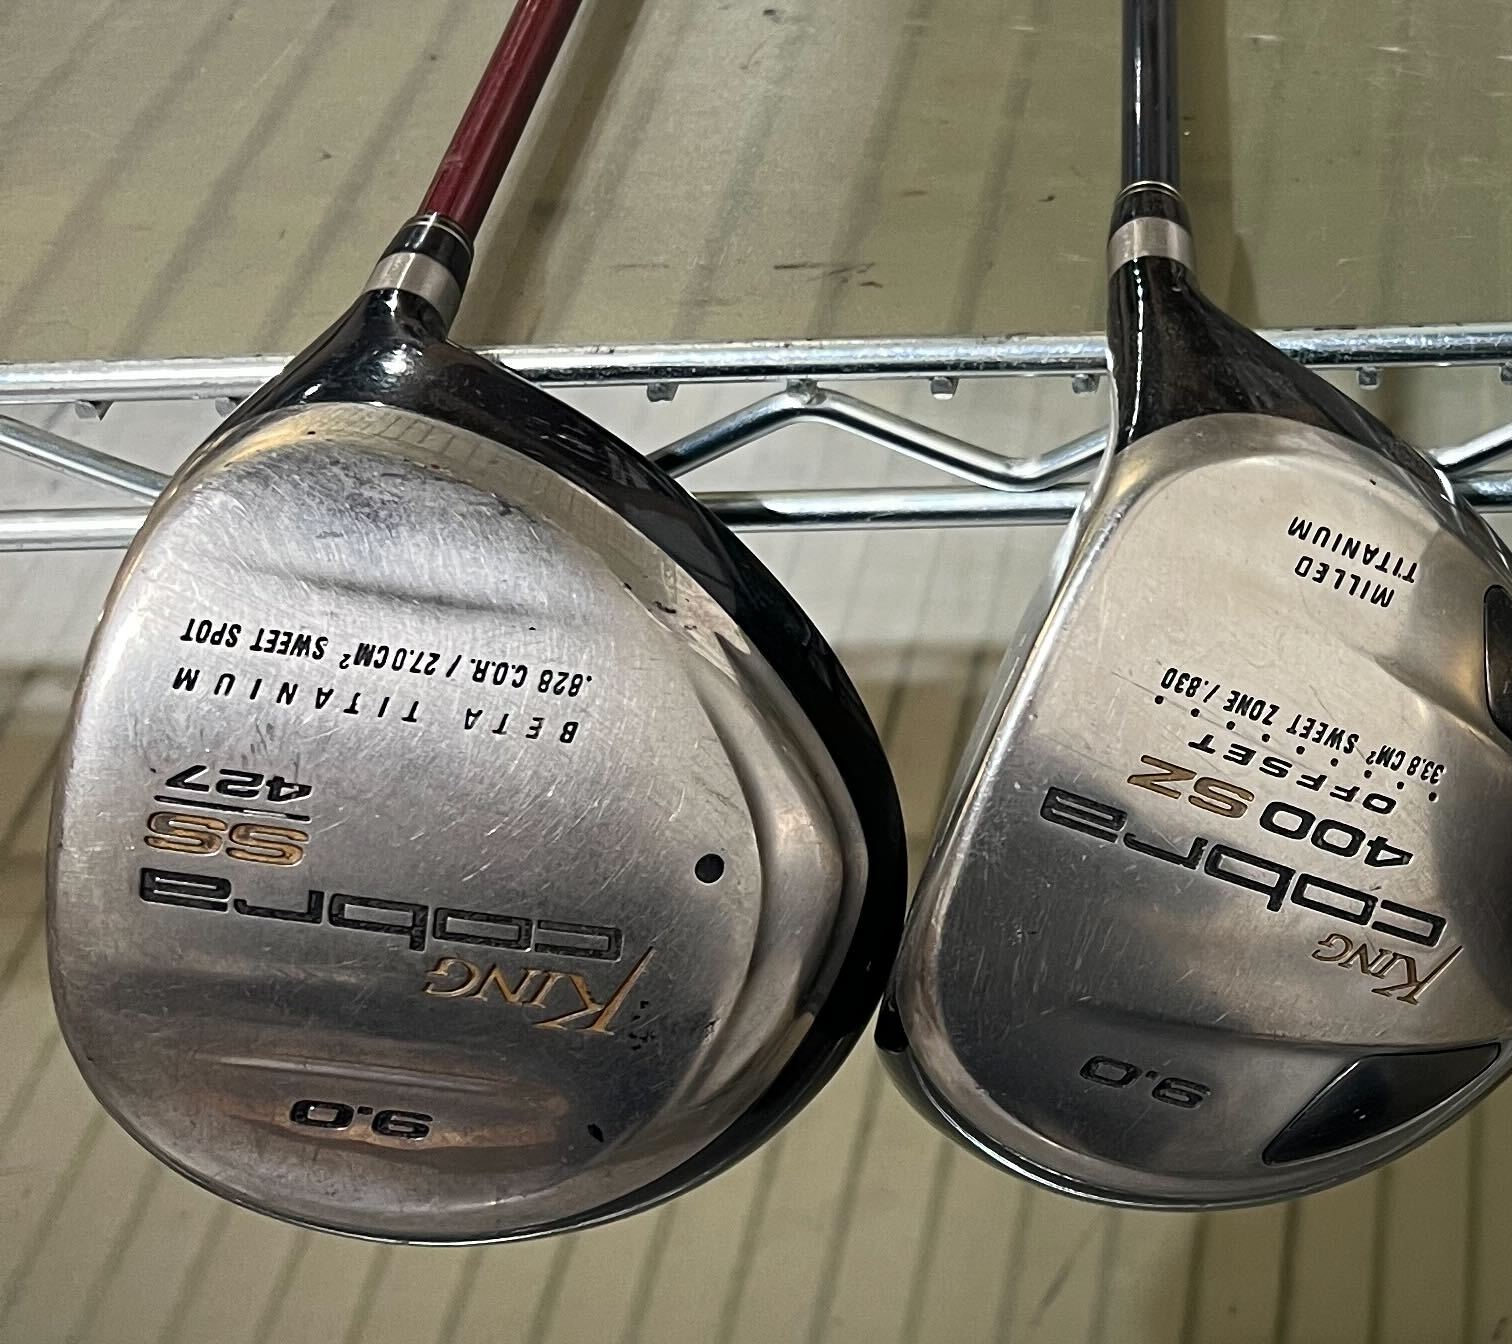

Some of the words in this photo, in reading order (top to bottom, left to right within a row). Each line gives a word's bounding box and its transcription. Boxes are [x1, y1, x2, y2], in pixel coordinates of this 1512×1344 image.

[1287, 515, 1419, 583] TITANIUM
[1294, 554, 1395, 608] MILLED
[180, 618, 242, 648] SPOT
[249, 627, 329, 660] SWEET
[172, 666, 420, 724] TITANIUM
[470, 658, 528, 689] C.O.R.
[463, 707, 579, 744] BETA
[1222, 690, 1280, 726] ZONE
[1286, 714, 1360, 754] SWEET
[165, 764, 313, 802] 427
[1126, 754, 1255, 819] SZ
[1188, 733, 1397, 815] OFFSET
[143, 811, 310, 867] SS
[1259, 800, 1413, 869] 400
[1039, 785, 1447, 948] cobra
[139, 867, 625, 963] cobra
[1079, 1055, 1211, 1109] 9.0
[289, 1099, 433, 1139] 9.0
